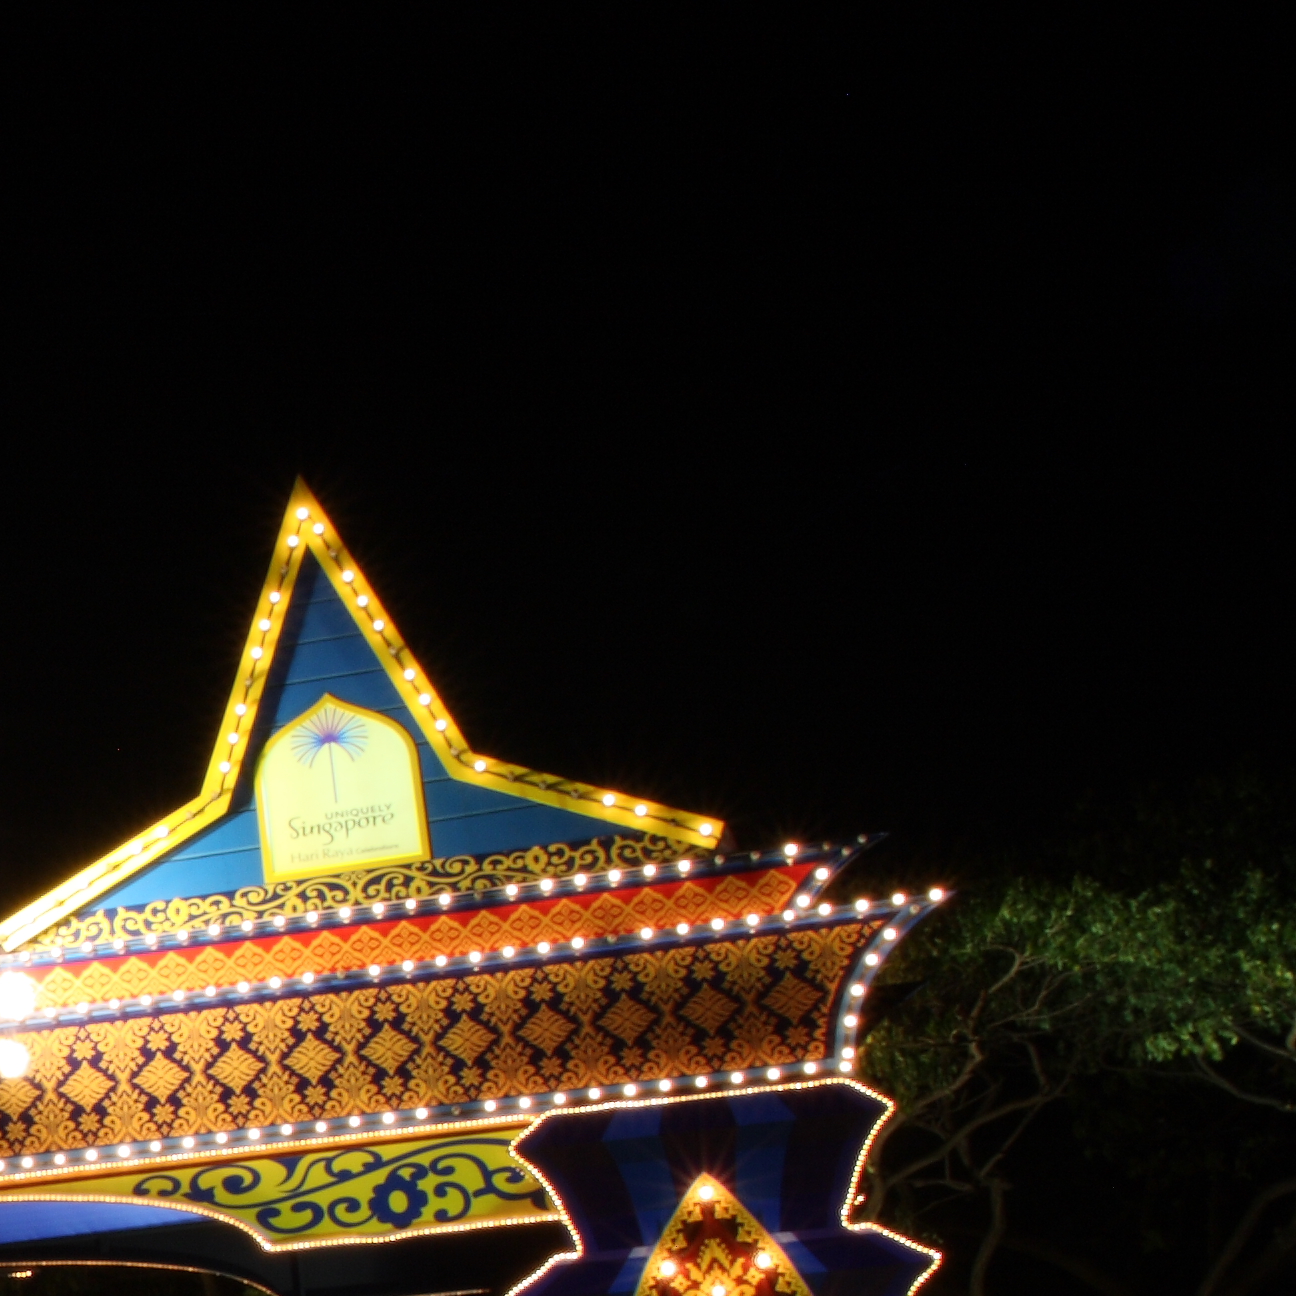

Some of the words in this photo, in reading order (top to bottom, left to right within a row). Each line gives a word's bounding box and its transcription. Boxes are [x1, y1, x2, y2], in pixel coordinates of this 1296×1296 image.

[324, 803, 392, 820] UNIQUELY
[288, 812, 394, 846] Singapore
[290, 850, 320, 864] Hari
[322, 847, 354, 861] Raya
